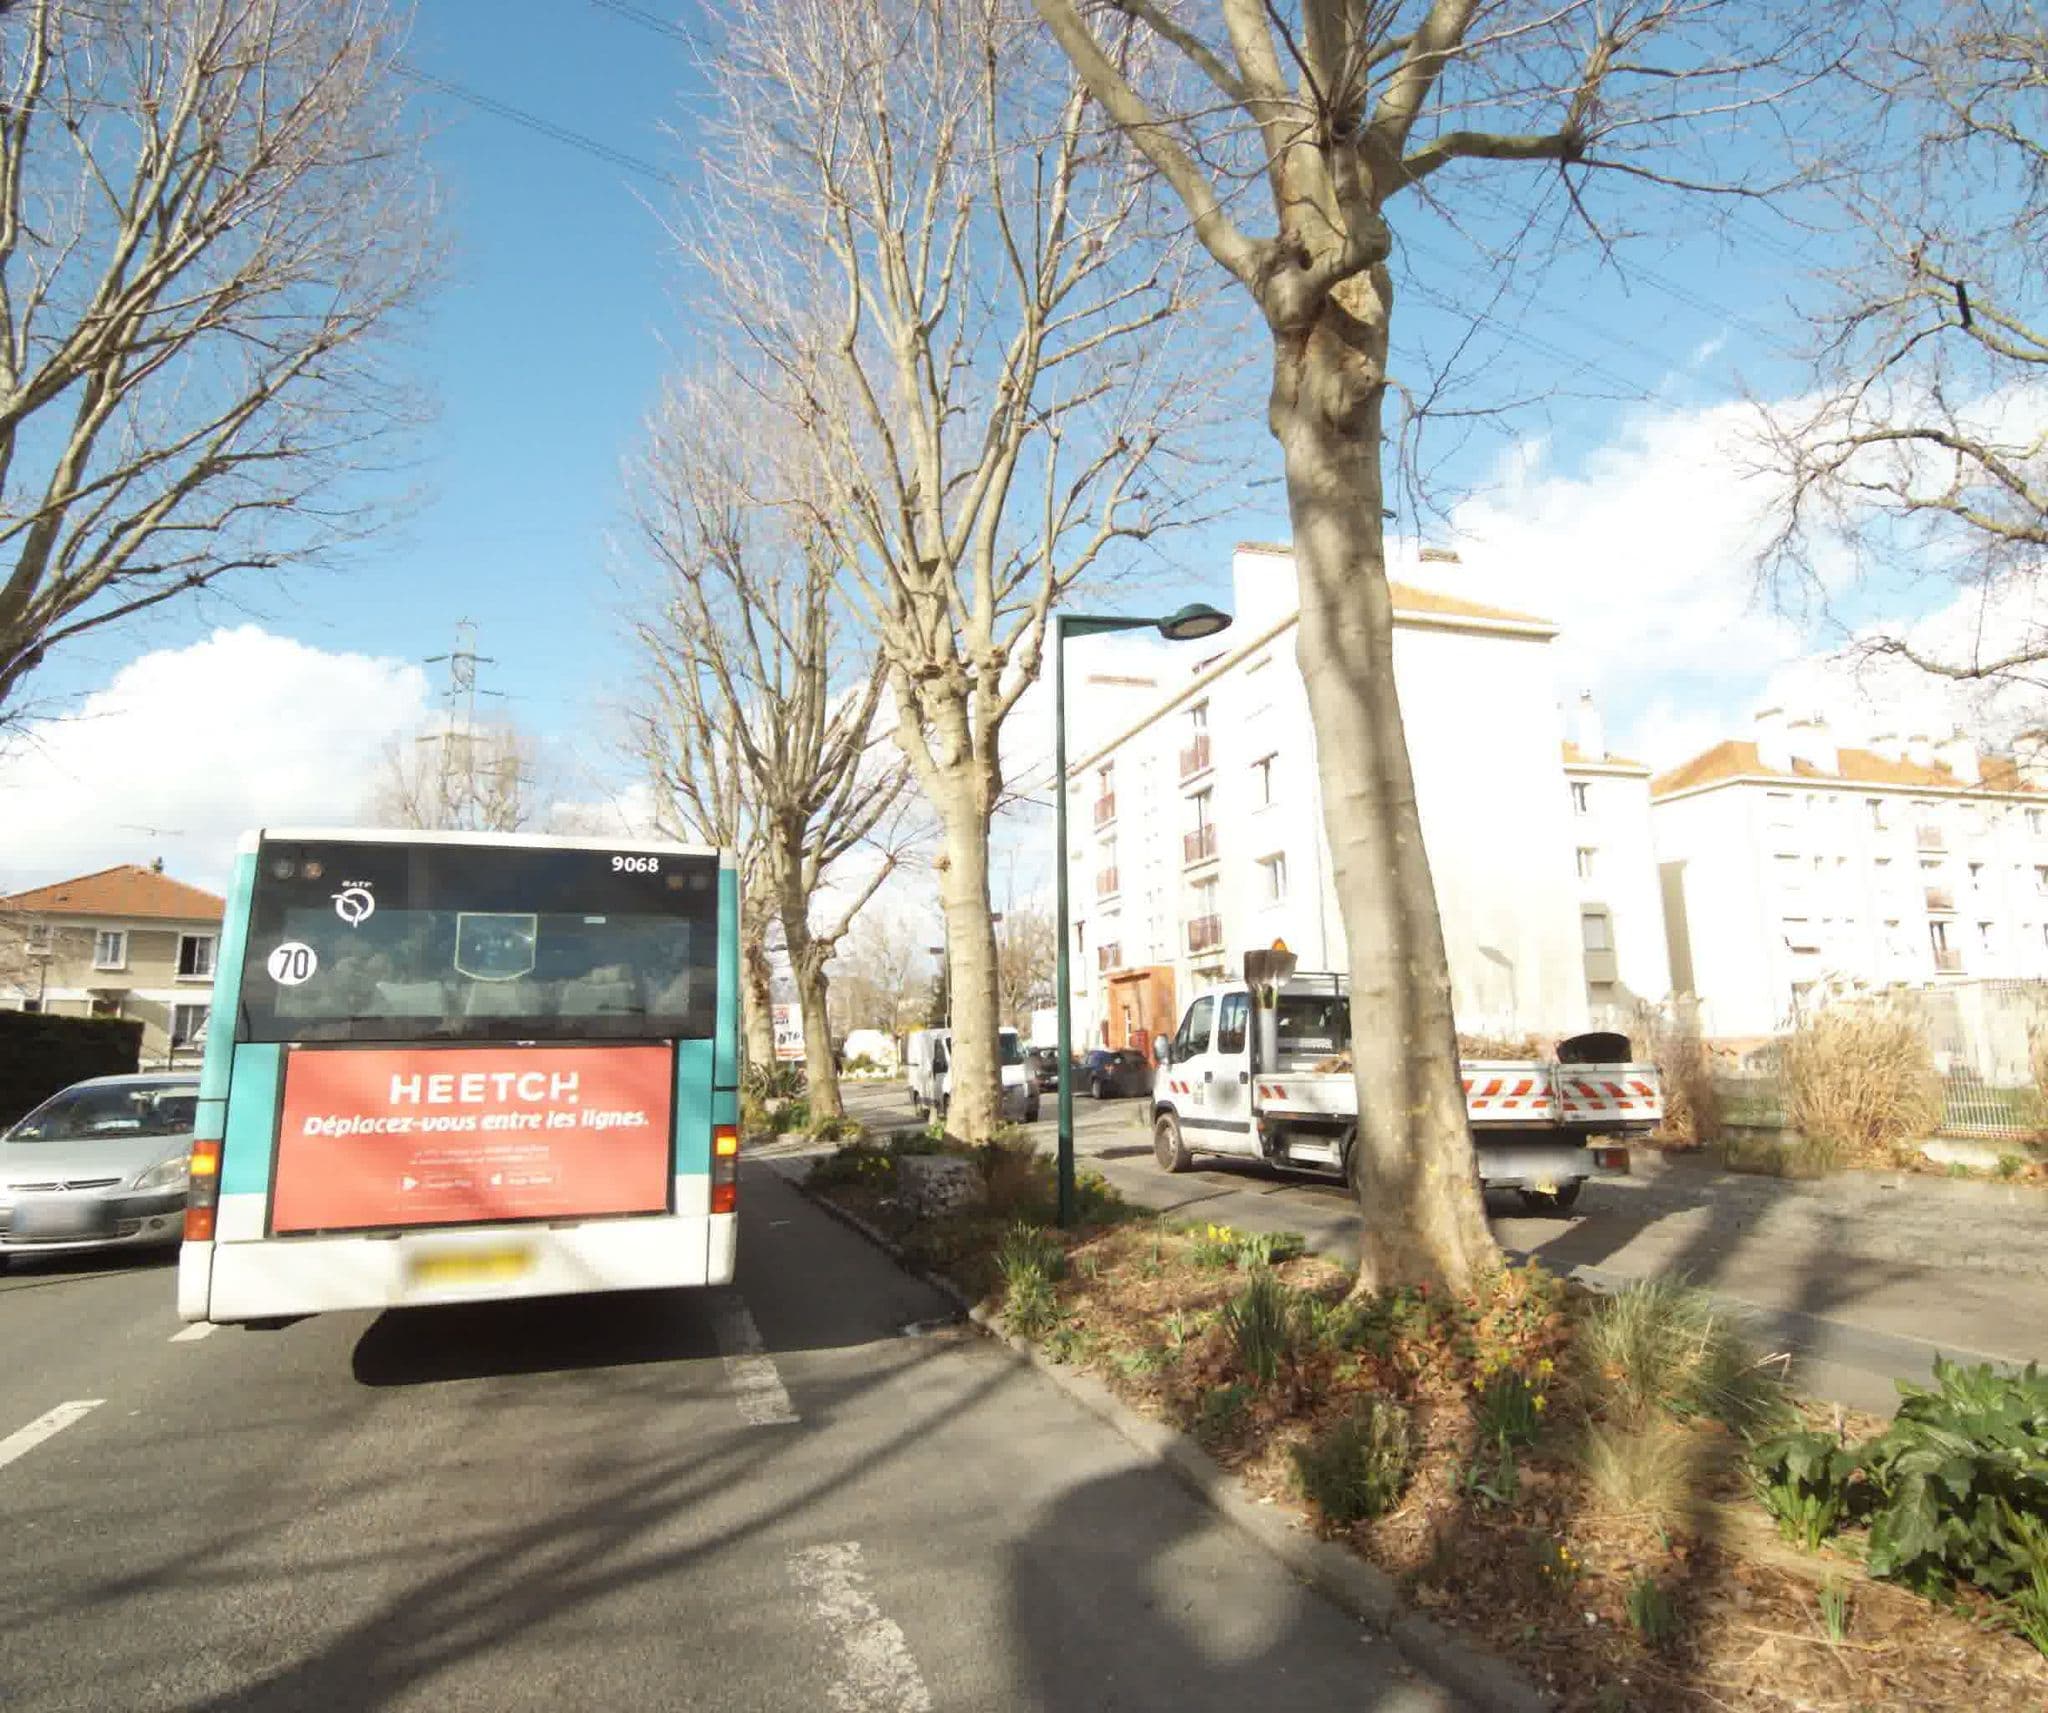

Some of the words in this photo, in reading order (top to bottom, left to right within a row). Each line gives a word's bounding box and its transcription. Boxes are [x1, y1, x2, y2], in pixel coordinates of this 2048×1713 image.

[612, 856, 659, 873] 9068
[279, 949, 309, 979] 70
[303, 1114, 477, 1138] Déplacez-vous
[481, 1111, 542, 1129] entre
[546, 1110, 577, 1128] les
[581, 1109, 649, 1130] lignes.
